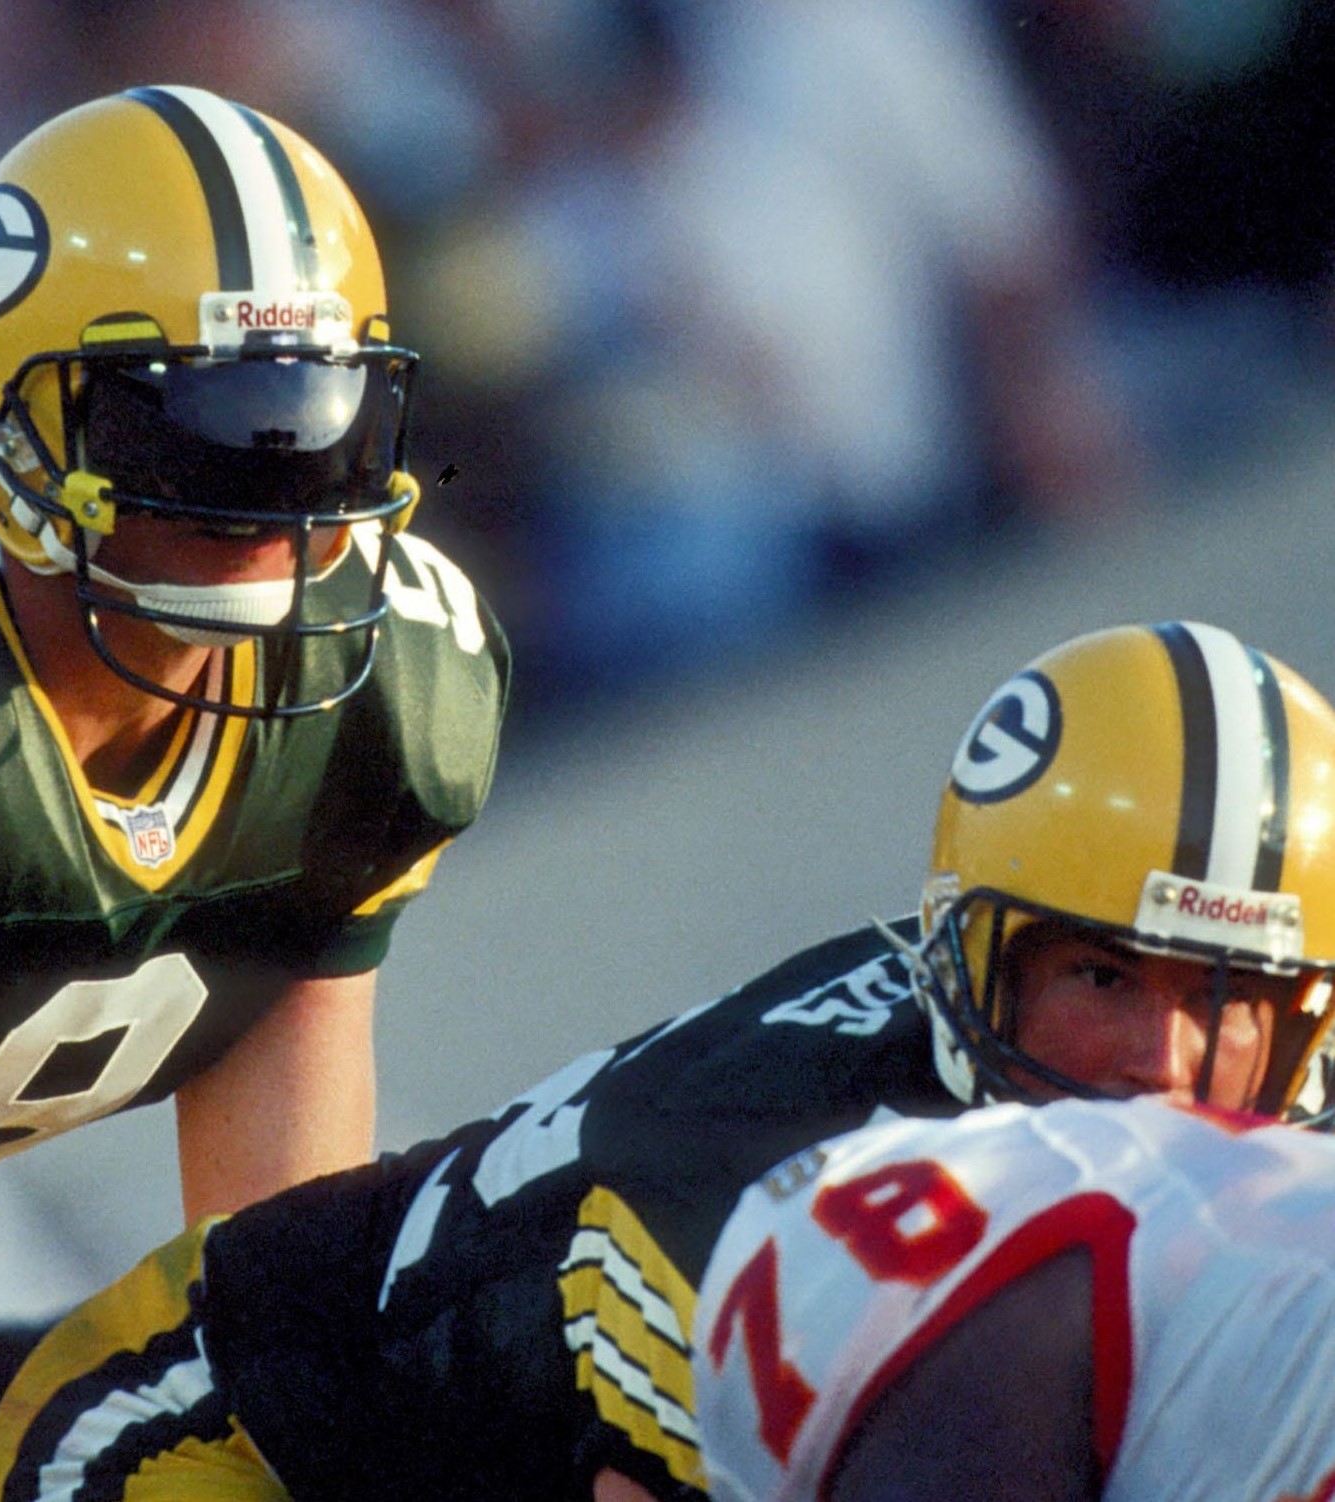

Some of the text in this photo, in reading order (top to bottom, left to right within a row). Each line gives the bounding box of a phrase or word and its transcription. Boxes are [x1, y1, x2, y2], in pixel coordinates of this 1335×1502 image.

[236, 300, 317, 328] Riddell
[951, 678, 1050, 793] G
[137, 829, 169, 858] NFL
[1178, 885, 1268, 926] Riddell
[707, 1158, 988, 1470] 78
